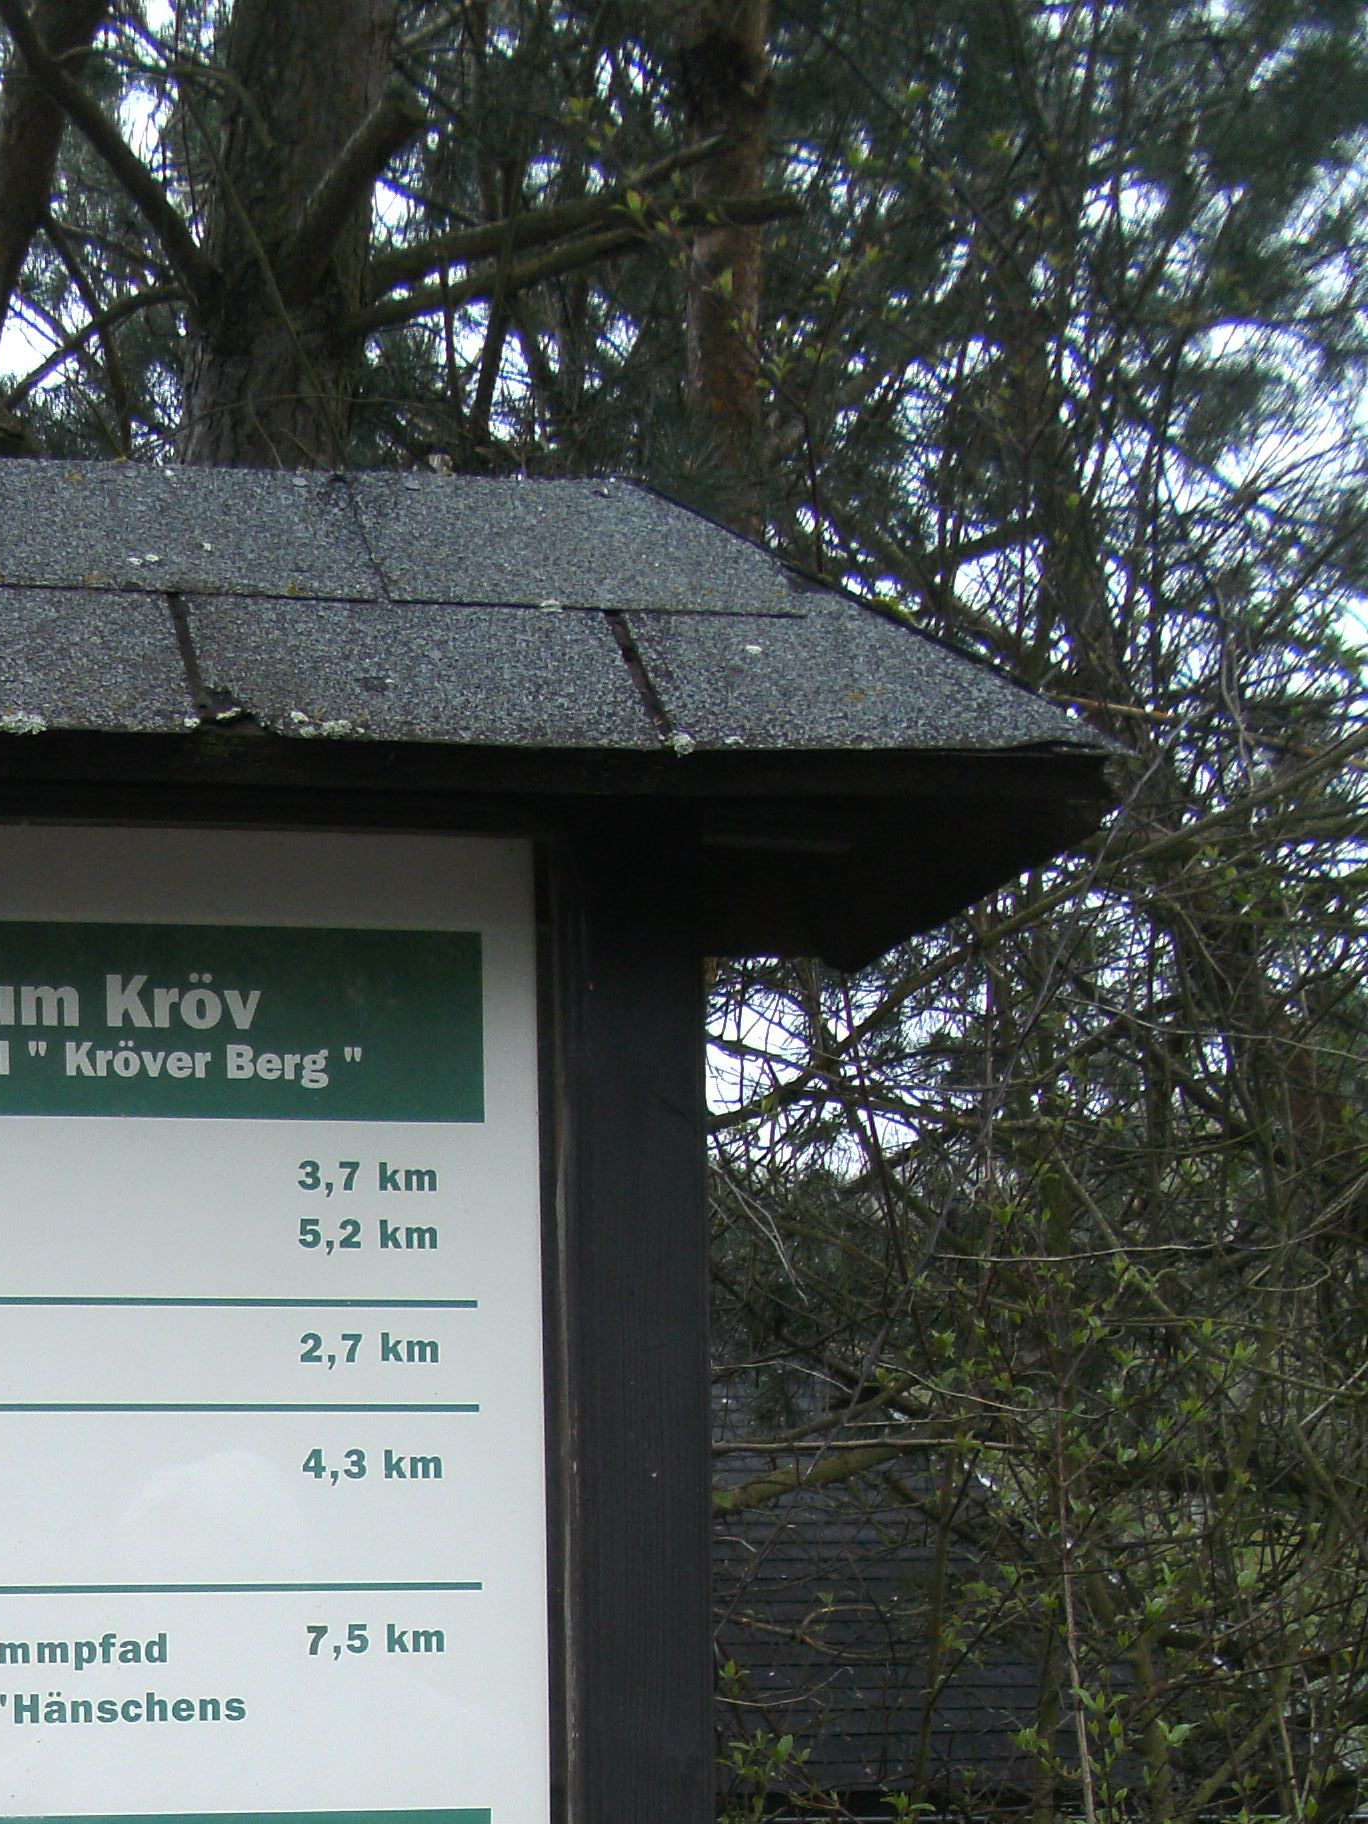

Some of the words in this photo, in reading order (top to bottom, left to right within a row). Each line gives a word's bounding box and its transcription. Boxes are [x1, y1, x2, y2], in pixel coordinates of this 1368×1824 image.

[106, 972, 261, 1030] Kröv
[64, 1039, 212, 1079] Kröver
[226, 1043, 330, 1089] Berg
[297, 1159, 361, 1198] 3,7
[378, 1161, 438, 1192] km
[298, 1217, 362, 1256] 5,2
[378, 1218, 438, 1250] km
[300, 1332, 363, 1371] 2,7
[380, 1331, 439, 1364] km
[302, 1448, 367, 1487] 4,3
[383, 1448, 443, 1479] km
[306, 1623, 370, 1661] 7,5
[386, 1623, 445, 1654] km
